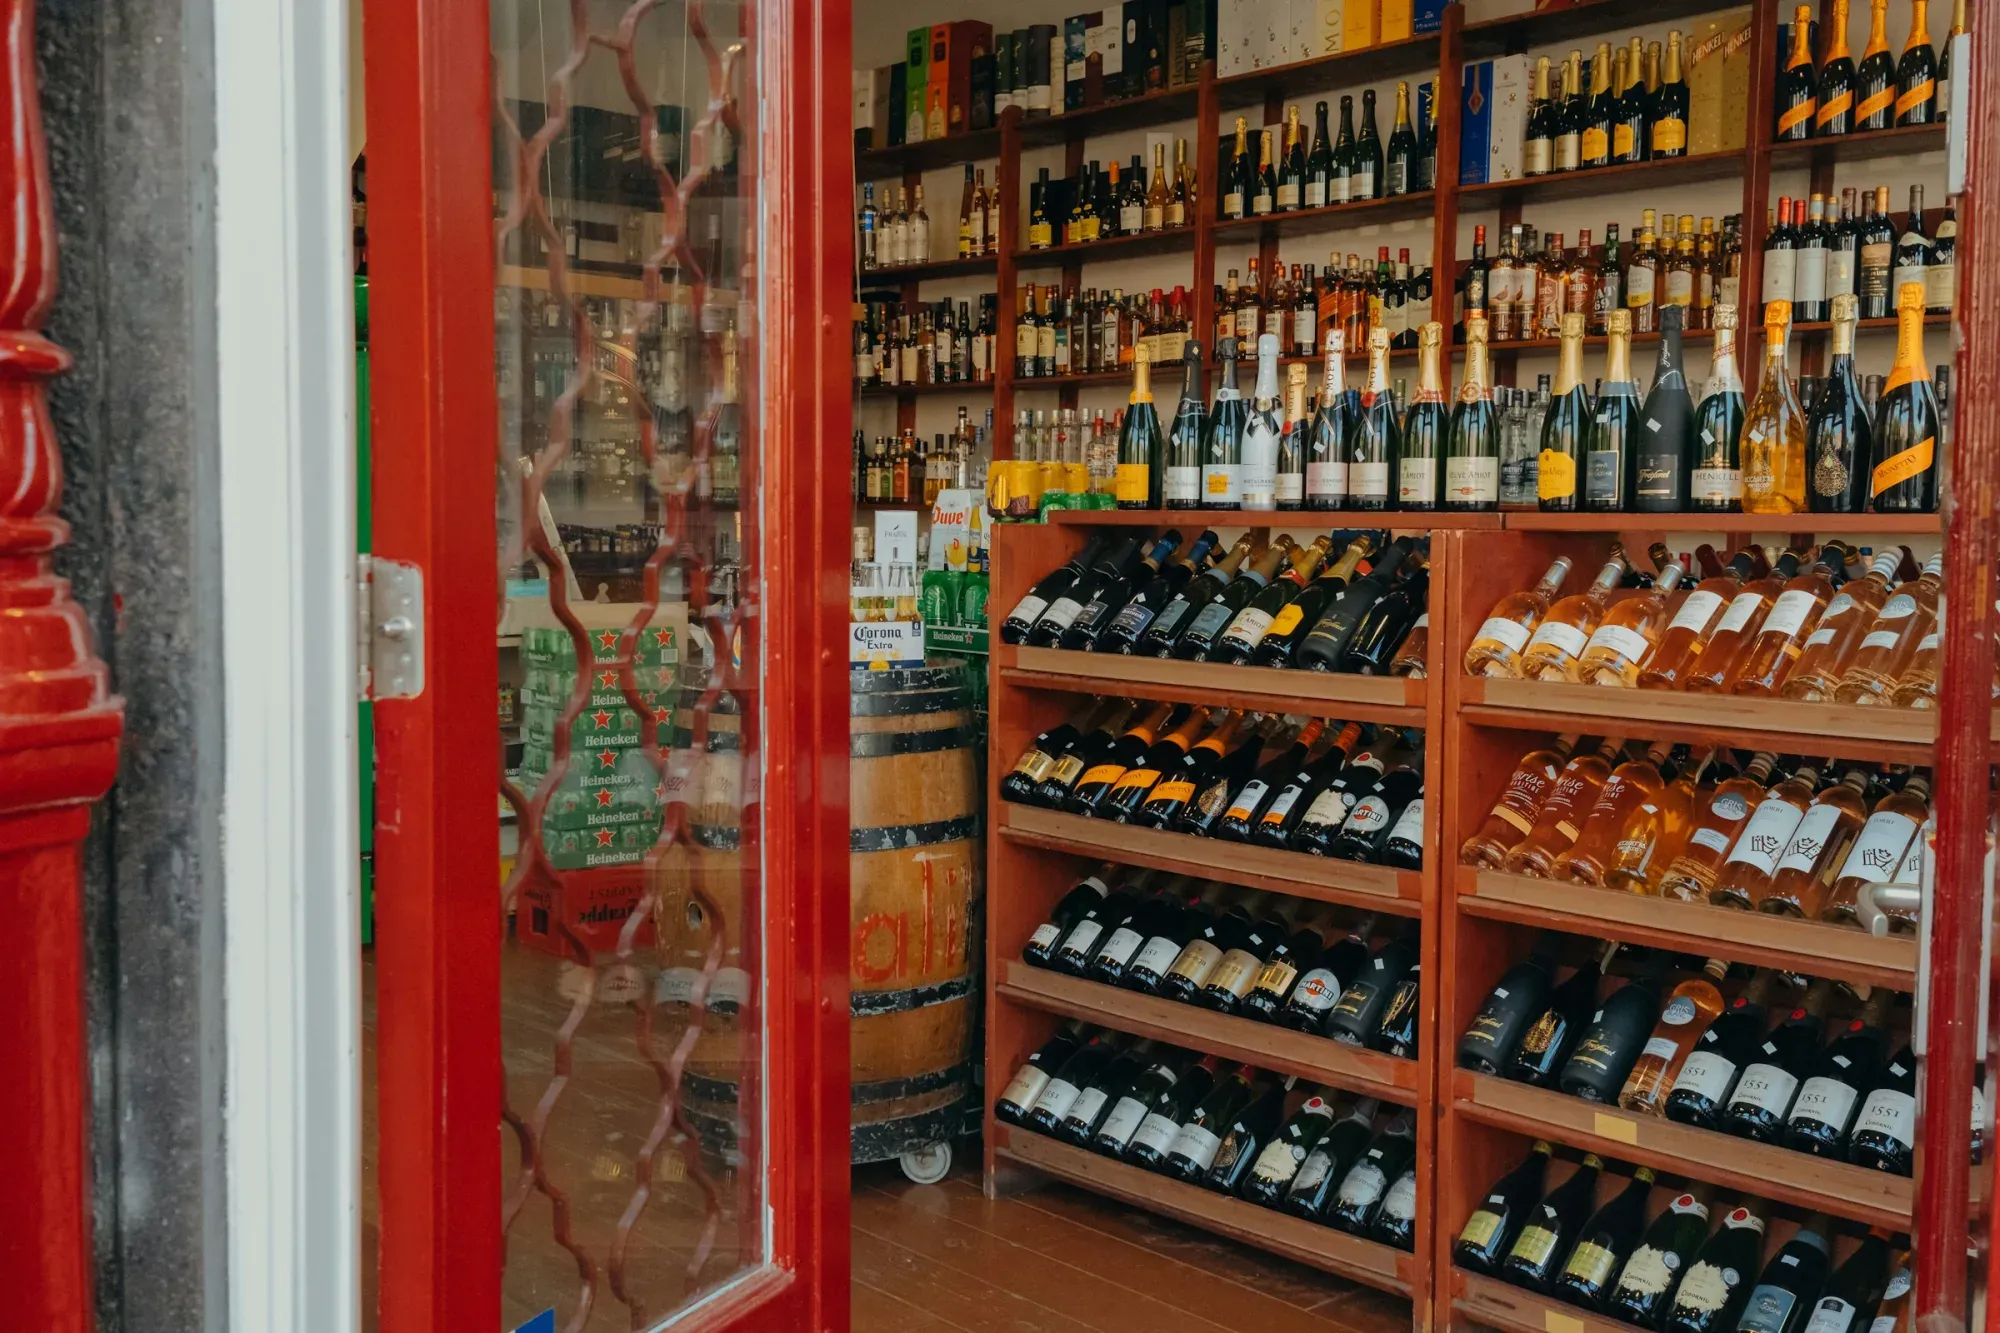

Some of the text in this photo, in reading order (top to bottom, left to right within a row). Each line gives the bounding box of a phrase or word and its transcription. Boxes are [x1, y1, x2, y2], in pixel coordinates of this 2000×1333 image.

[1724, 26, 1752, 59] HENKEL
[1695, 472, 1739, 481] HENKELL
[854, 626, 902, 643] Corona
[933, 631, 964, 641] Heineken
[867, 640, 893, 650] Extra
[585, 733, 639, 747] Heineken
[579, 774, 631, 788] Heineken
[1720, 797, 1743, 810] GRIS
[587, 812, 639, 825] Heineken
[586, 852, 639, 866] Heineken
[1300, 981, 1334, 1000] MARTINI
[1669, 1003, 1689, 1013] GRIS
[1743, 1079, 1769, 1091] 1551
[1801, 1093, 1827, 1104] 1551
[1871, 1105, 1901, 1118] 1551
